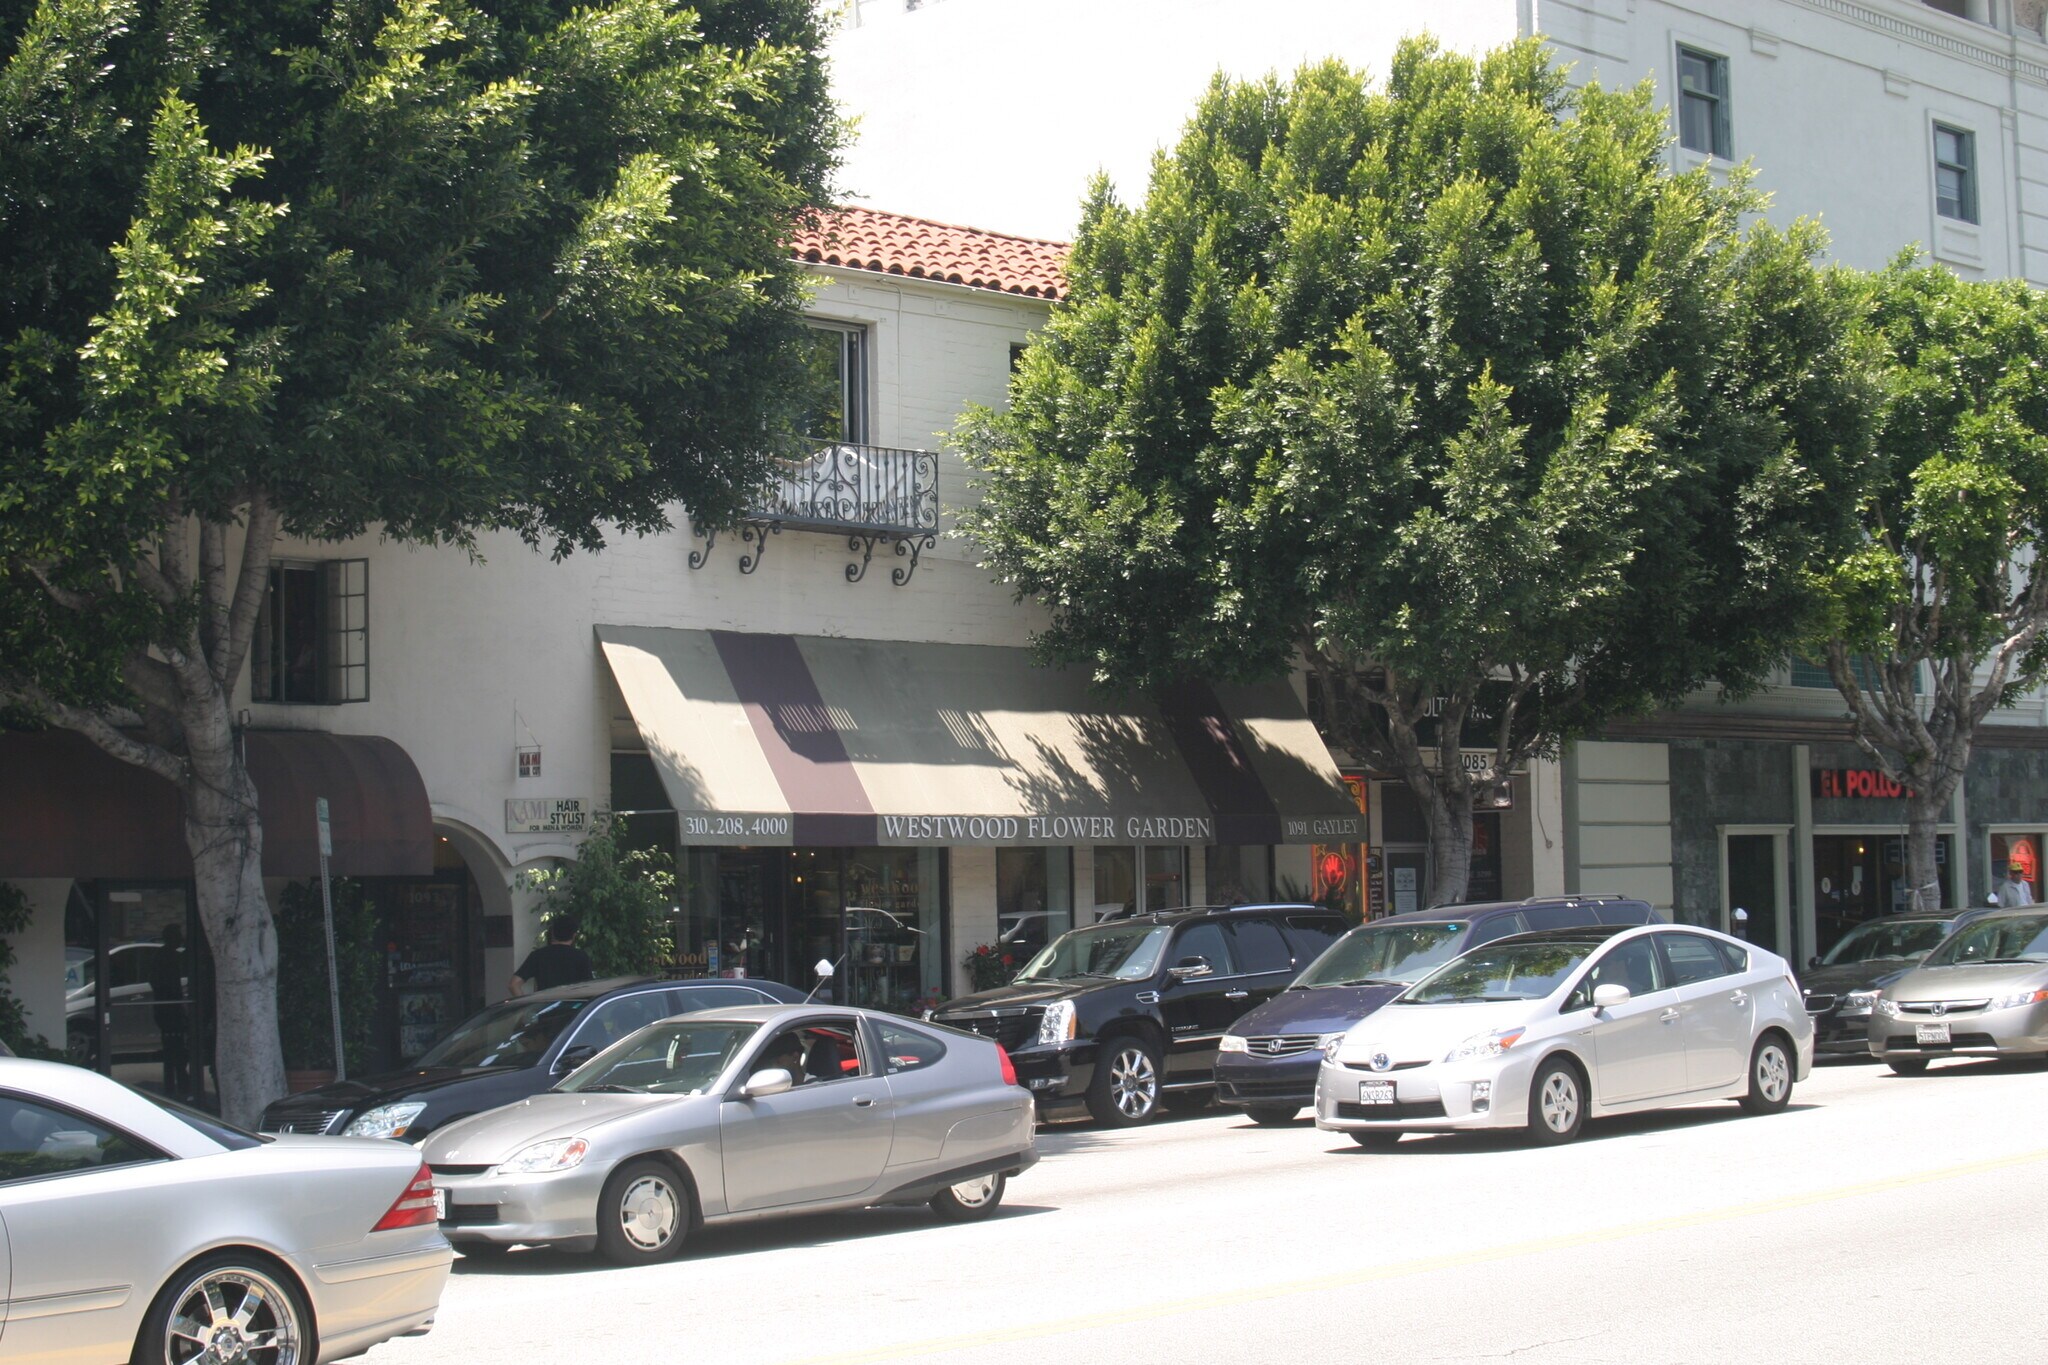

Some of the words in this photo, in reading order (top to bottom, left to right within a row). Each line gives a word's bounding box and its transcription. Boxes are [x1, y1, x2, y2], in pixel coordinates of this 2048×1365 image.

[520, 753, 541, 766] KAMI
[1820, 769, 1842, 798] EL
[1846, 769, 1902, 798] POLLO
[508, 801, 548, 824] KAMI
[556, 801, 579, 812] HAIR
[551, 812, 585, 824] STYLIST
[686, 817, 788, 836] 310.208.4000
[884, 816, 1018, 839] WESTWOOD
[1028, 817, 1115, 838] FLOWER
[1127, 817, 1210, 838] GARDEN
[1288, 821, 1307, 836] 1091
[1313, 819, 1358, 835] GAYLEY
